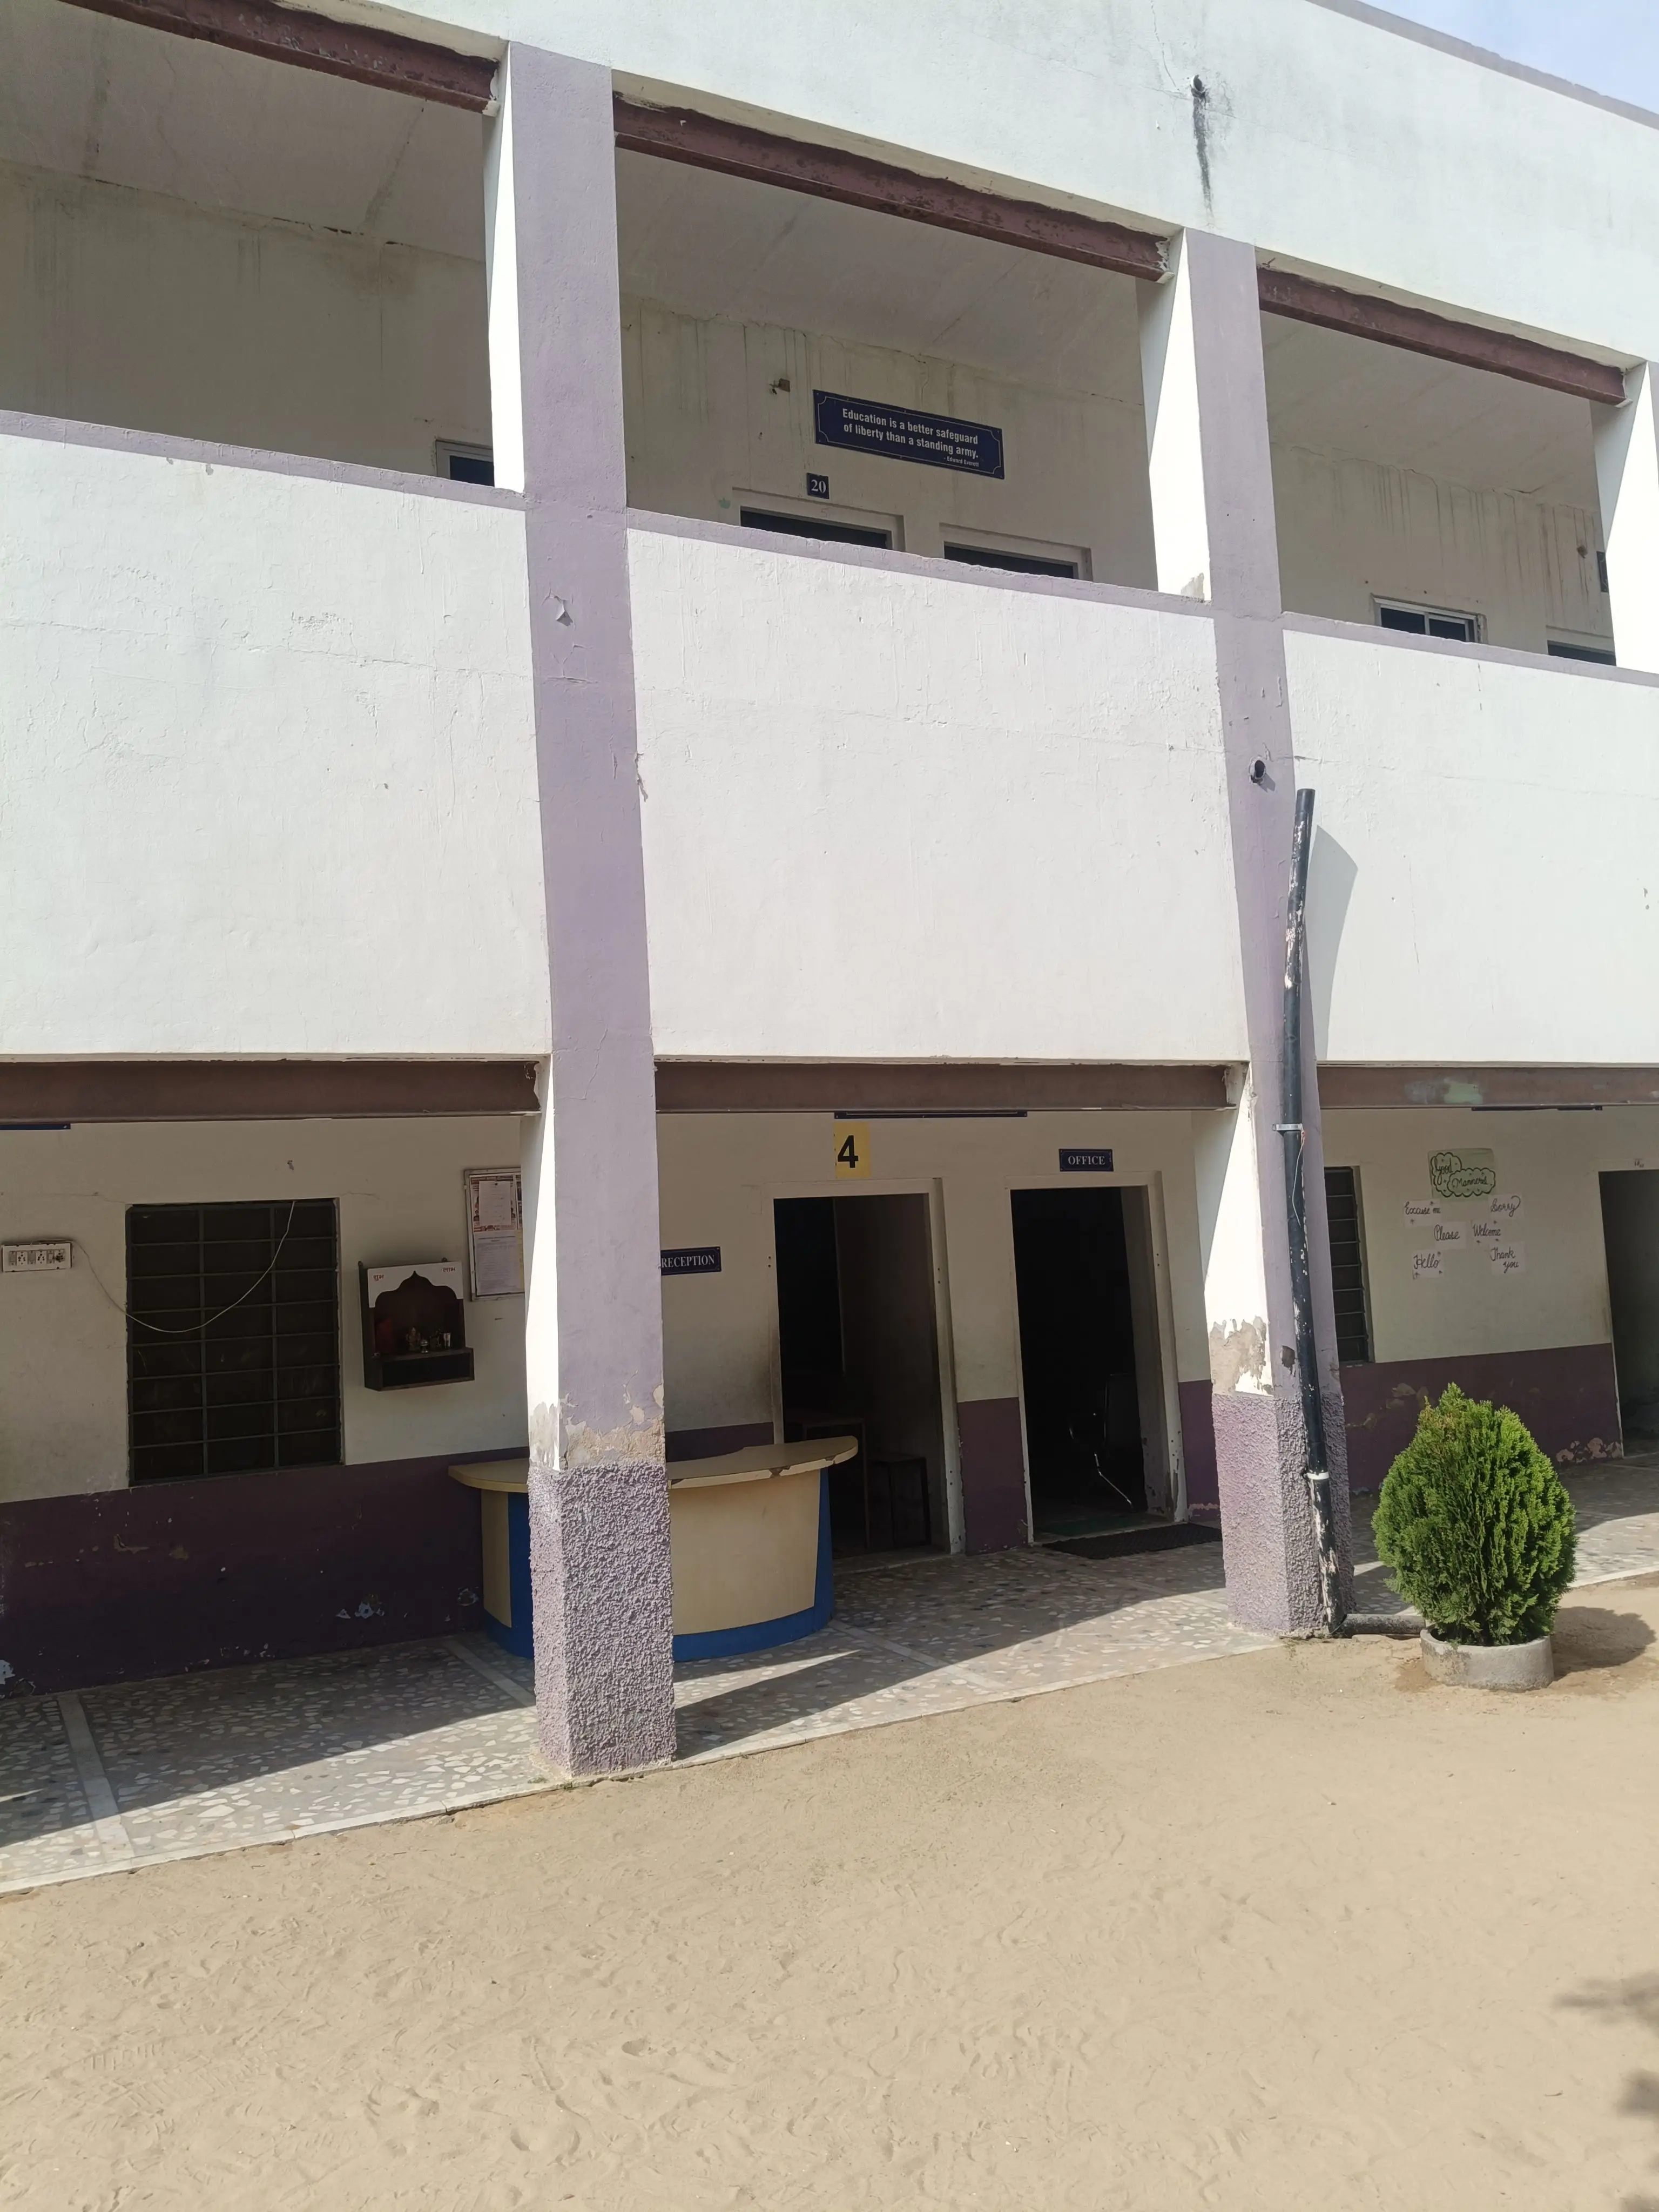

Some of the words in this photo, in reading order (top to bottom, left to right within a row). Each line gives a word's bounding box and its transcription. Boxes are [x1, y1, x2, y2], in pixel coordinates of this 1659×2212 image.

[842, 408, 887, 426] Education
[889, 417, 897, 428] is
[899, 422, 905, 430] a
[907, 421, 934, 435] better
[936, 429, 978, 444] safeguard
[844, 423, 853, 433] of
[855, 424, 884, 441] liberty
[886, 431, 906, 443] than
[908, 437, 914, 445] a
[916, 438, 953, 455] standing
[956, 447, 979, 459] army.
[811, 479, 826, 493] 20
[838, 1135, 859, 1168] 4
[1068, 1156, 1105, 1165] OFFICE
[1491, 1195, 1521, 1217] Sorry
[1434, 1224, 1460, 1241] Please
[1472, 1223, 1501, 1237] Welcome
[661, 1255, 714, 1268] RECEPTION
[1413, 1253, 1441, 1270] Hello
[1490, 1246, 1516, 1261] Thank
[1502, 1260, 1519, 1274] you
